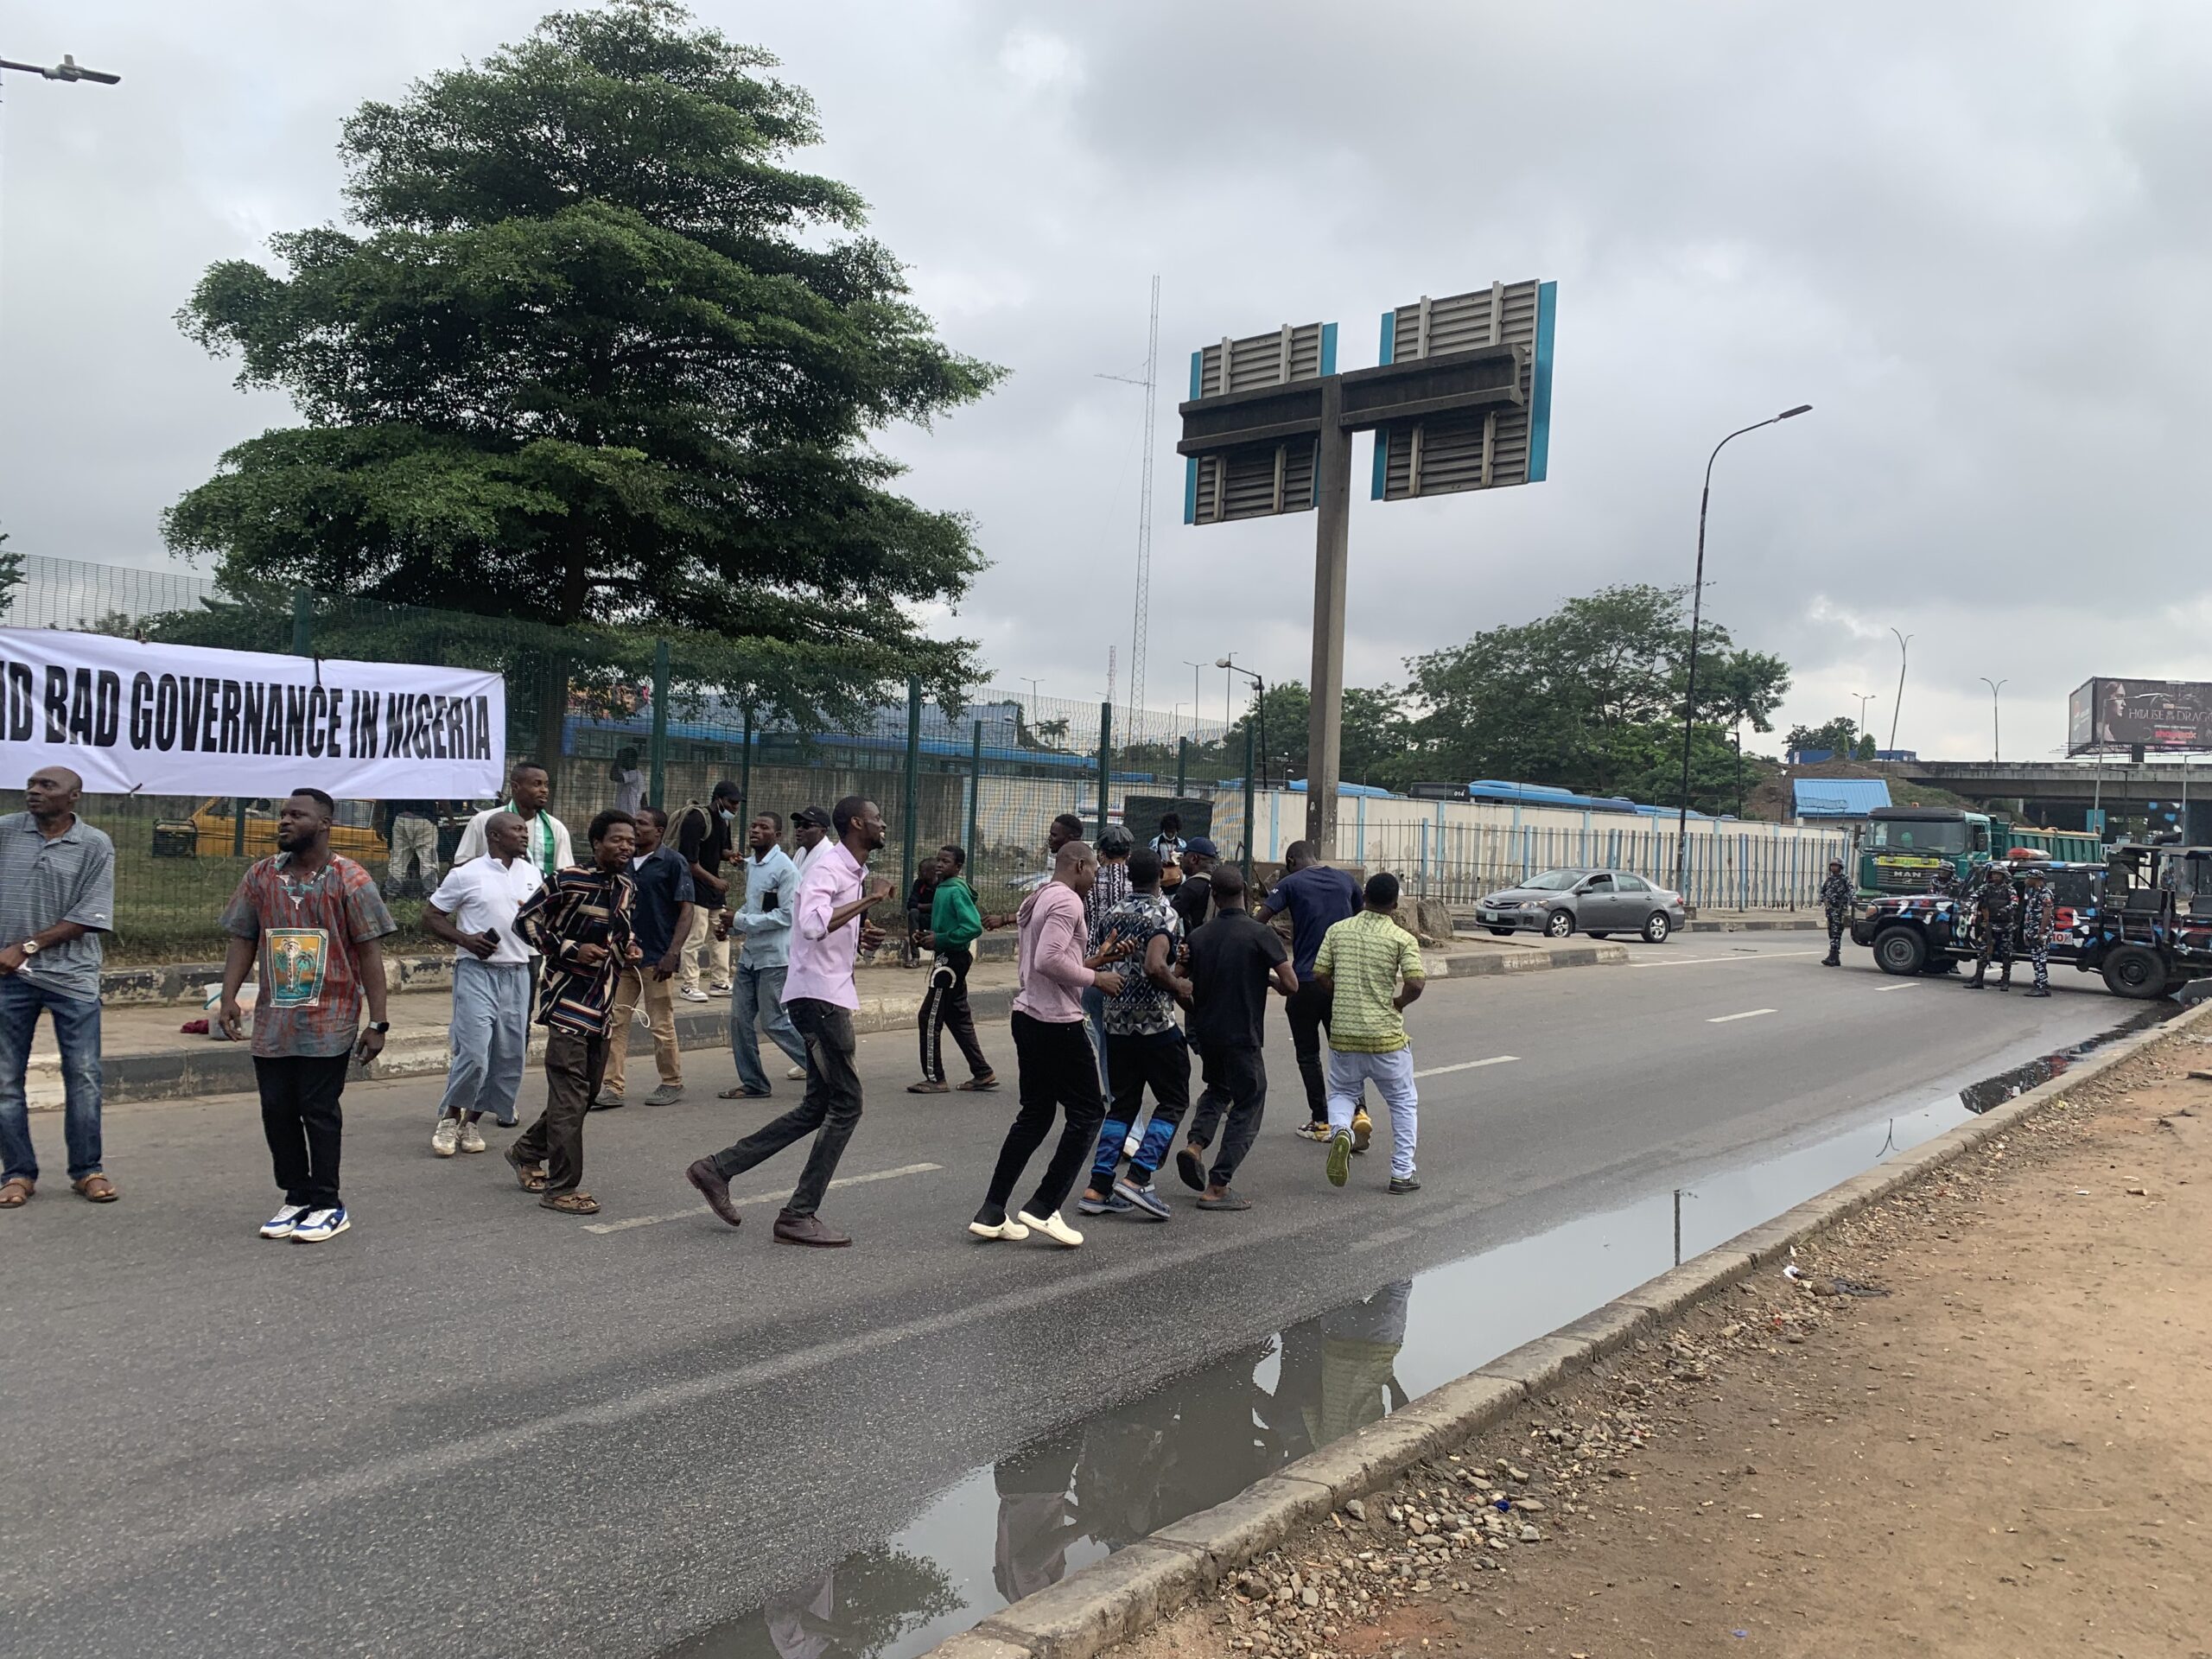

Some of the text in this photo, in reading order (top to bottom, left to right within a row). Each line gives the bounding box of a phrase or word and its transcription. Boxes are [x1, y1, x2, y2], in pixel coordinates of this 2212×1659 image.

[0, 661, 491, 760] D BAD GOVERNANCE IN NIGERIA
[2128, 709, 2164, 720] HOUSE
